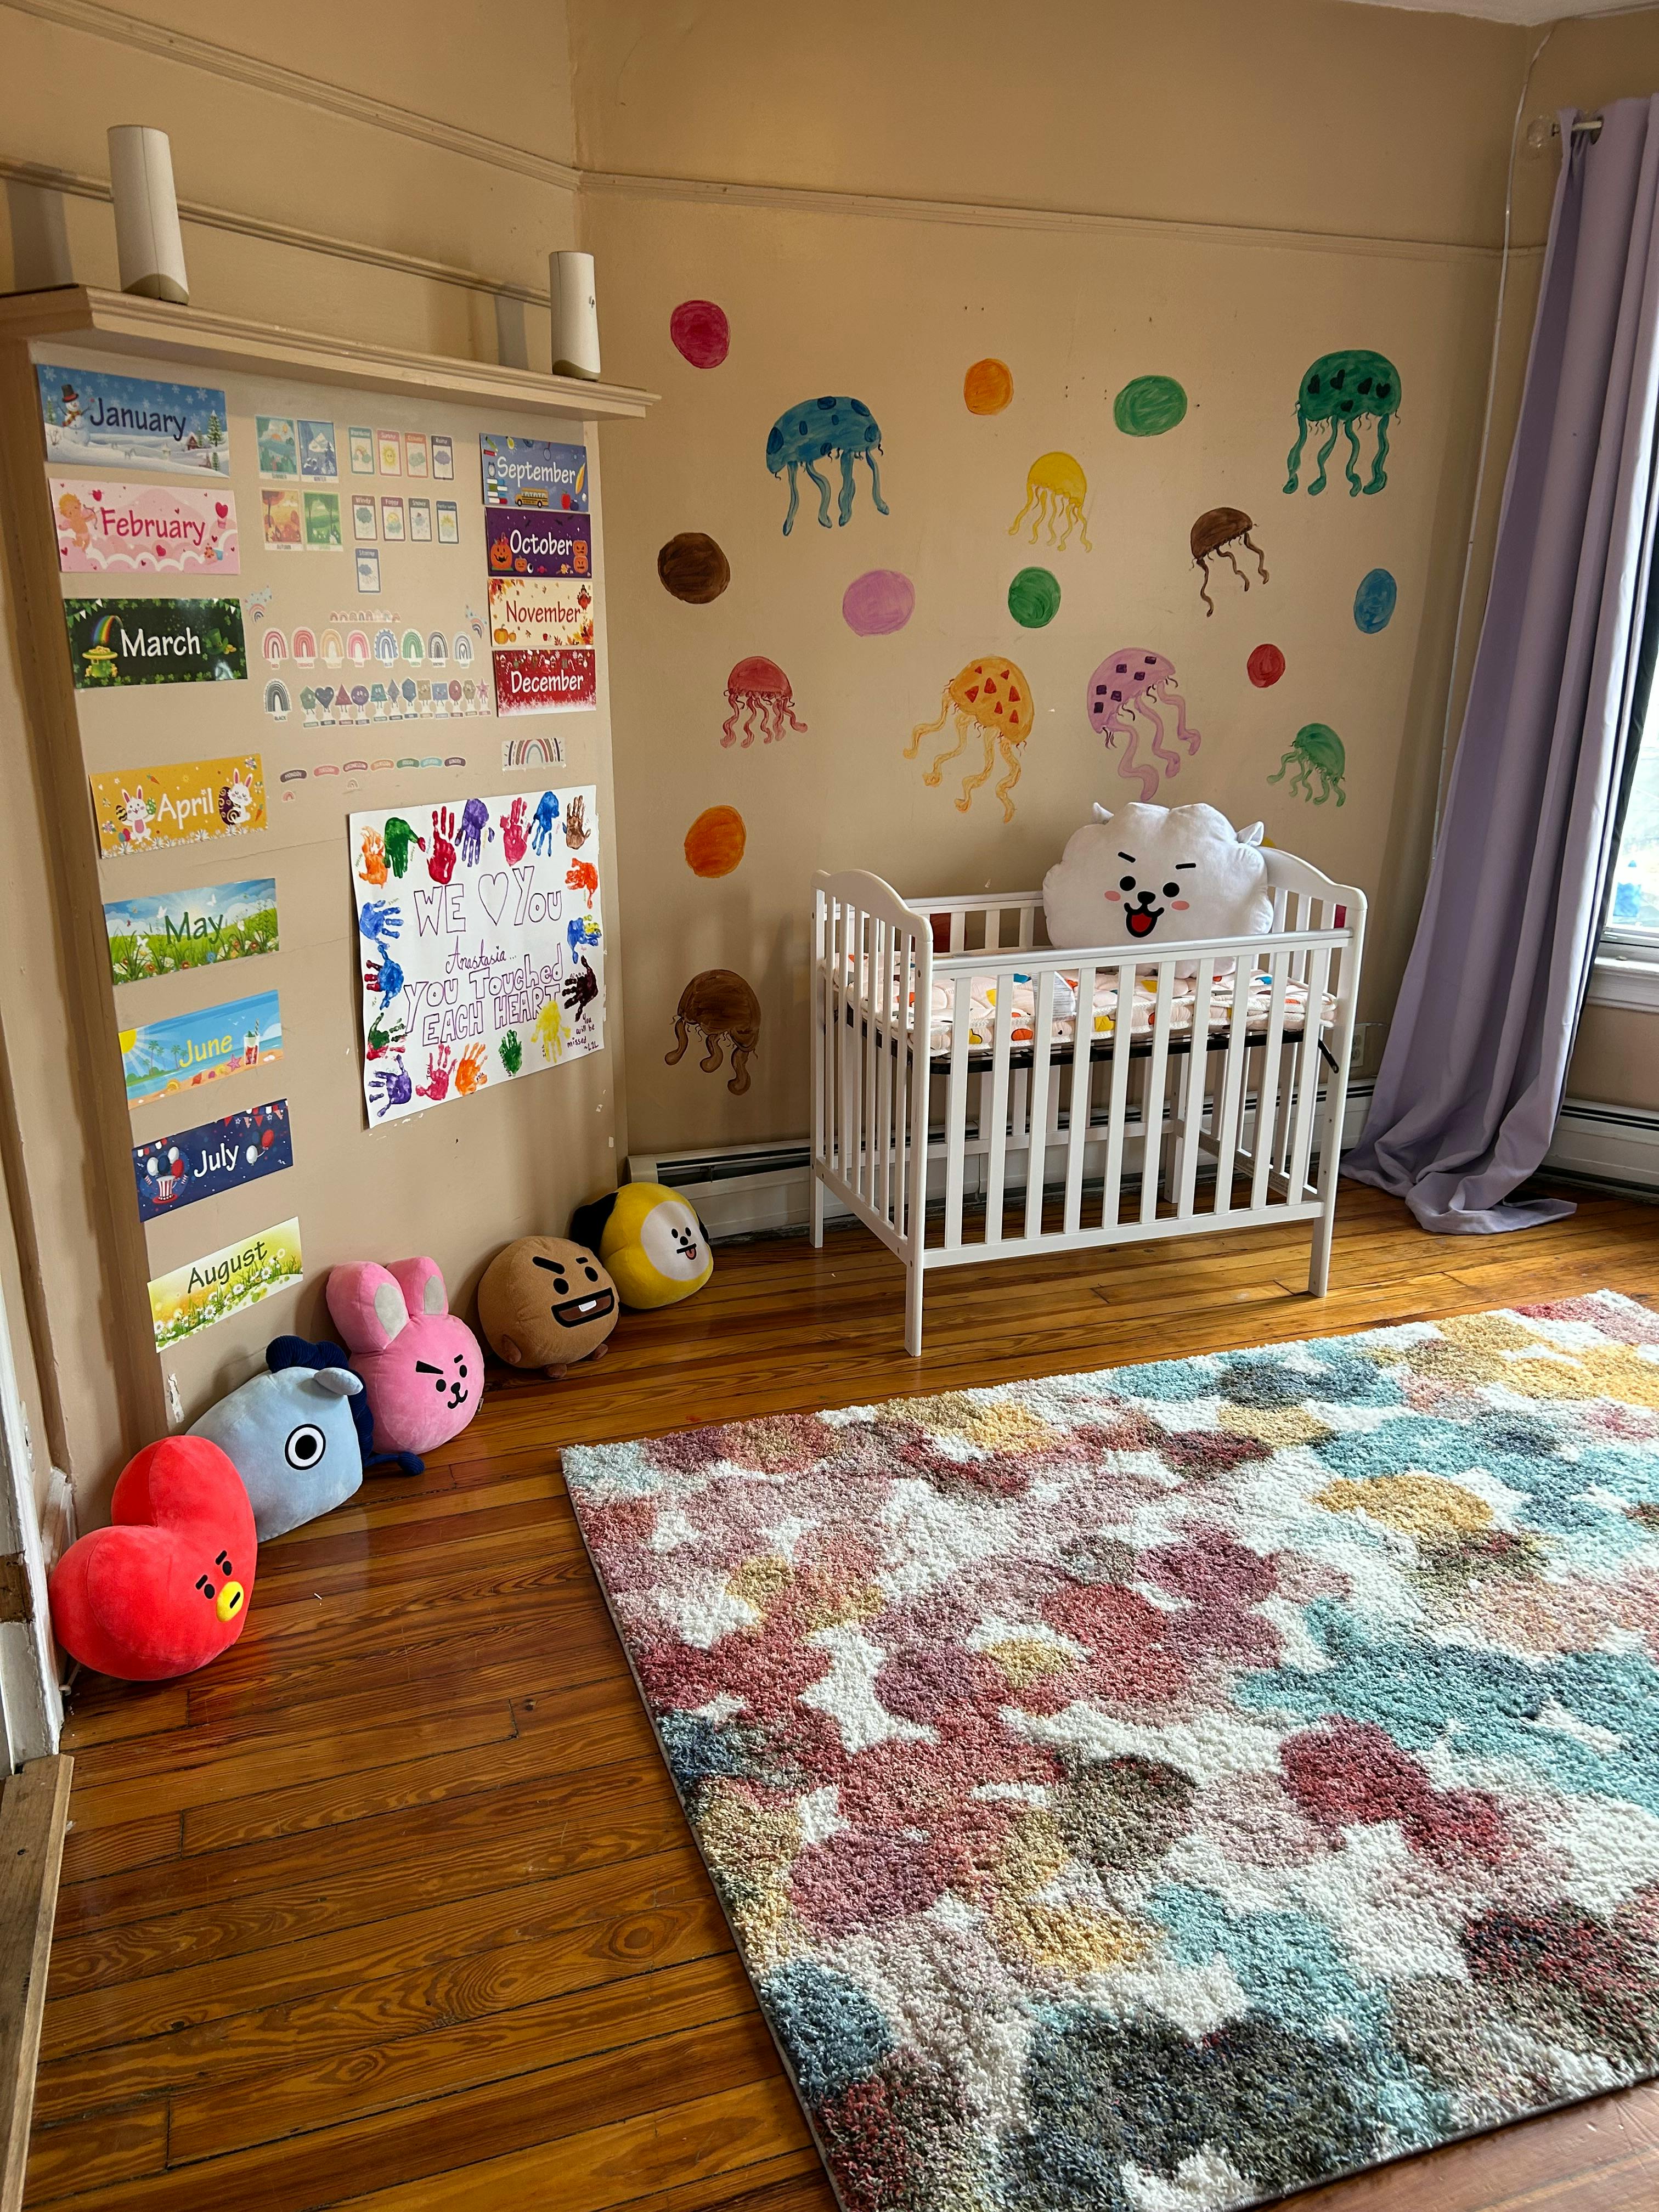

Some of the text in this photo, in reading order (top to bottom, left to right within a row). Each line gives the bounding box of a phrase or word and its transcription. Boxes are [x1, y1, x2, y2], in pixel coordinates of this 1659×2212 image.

[89, 398, 187, 441] January
[497, 456, 575, 487] September
[100, 506, 206, 546] February
[510, 529, 572, 555] October
[506, 600, 580, 623] November
[120, 627, 200, 657] March
[511, 669, 584, 693] December
[157, 788, 214, 830] April
[414, 883, 466, 937] WE
[164, 911, 224, 946] May
[422, 983, 561, 1047] EACH HEART
[576, 1024, 595, 1035] will be
[179, 1034, 233, 1068] June
[567, 1035, 587, 1048] missed
[193, 1142, 239, 1178] July
[187, 1240, 268, 1294] August
